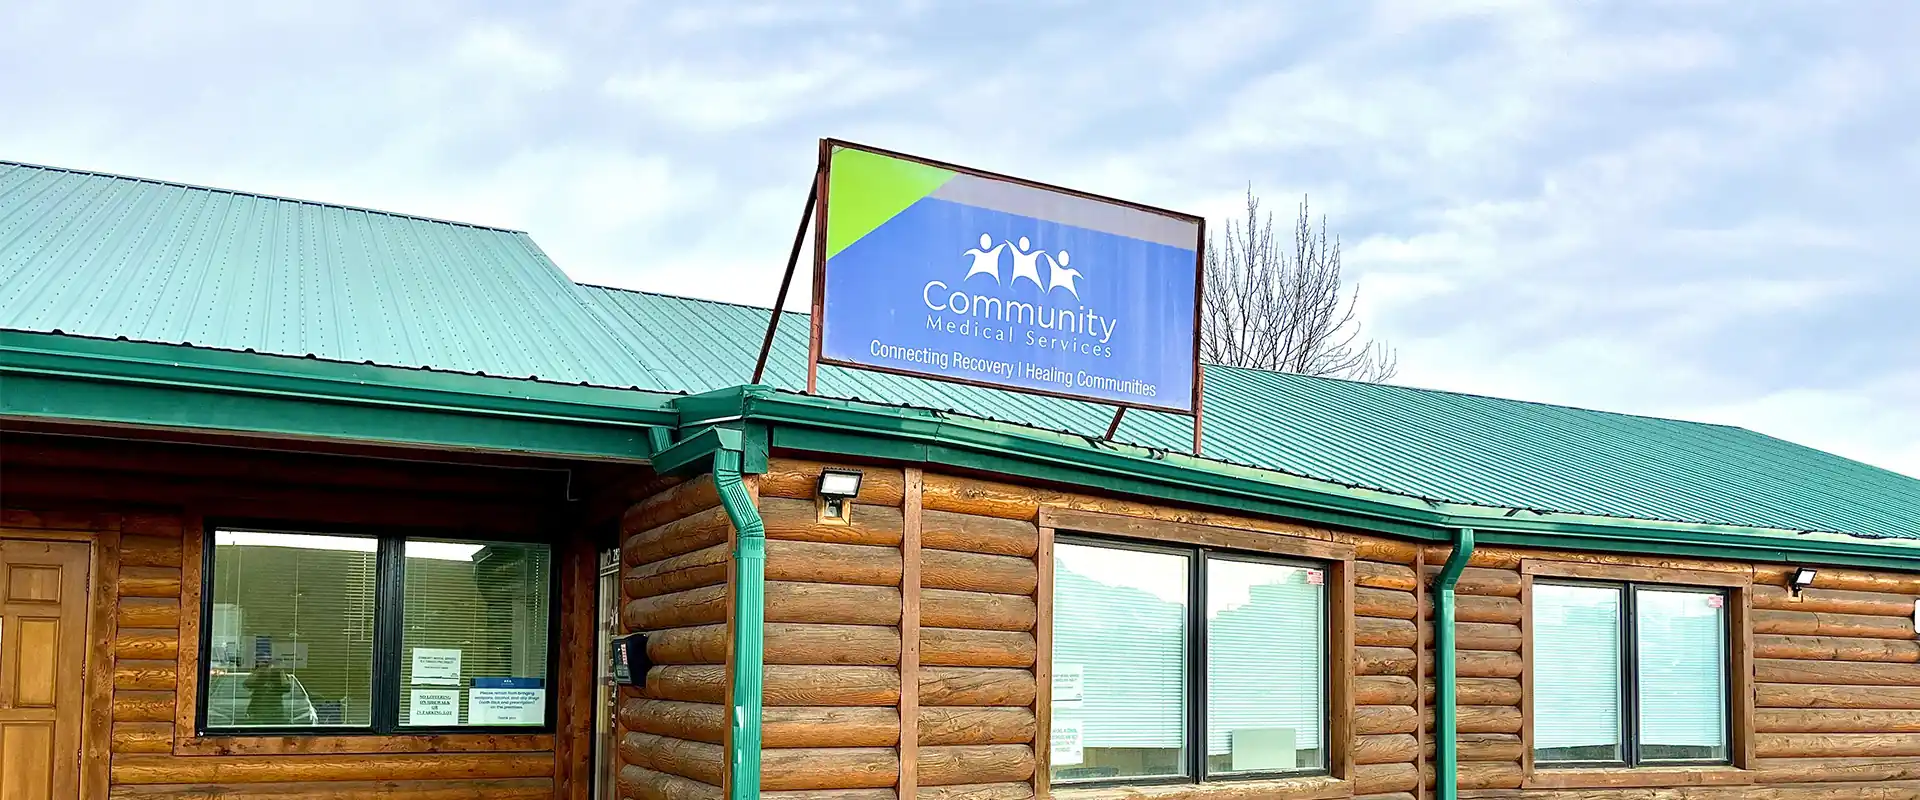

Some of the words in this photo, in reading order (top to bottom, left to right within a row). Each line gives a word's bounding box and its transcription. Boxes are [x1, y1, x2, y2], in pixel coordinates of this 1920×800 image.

[923, 280, 1117, 344] Community
[926, 314, 1013, 343] Medical
[1025, 330, 1112, 358] Services
[870, 339, 949, 370] Connecting
[952, 351, 1014, 379] Recovery
[1026, 362, 1073, 388] Healing
[1077, 370, 1157, 397] Communities
